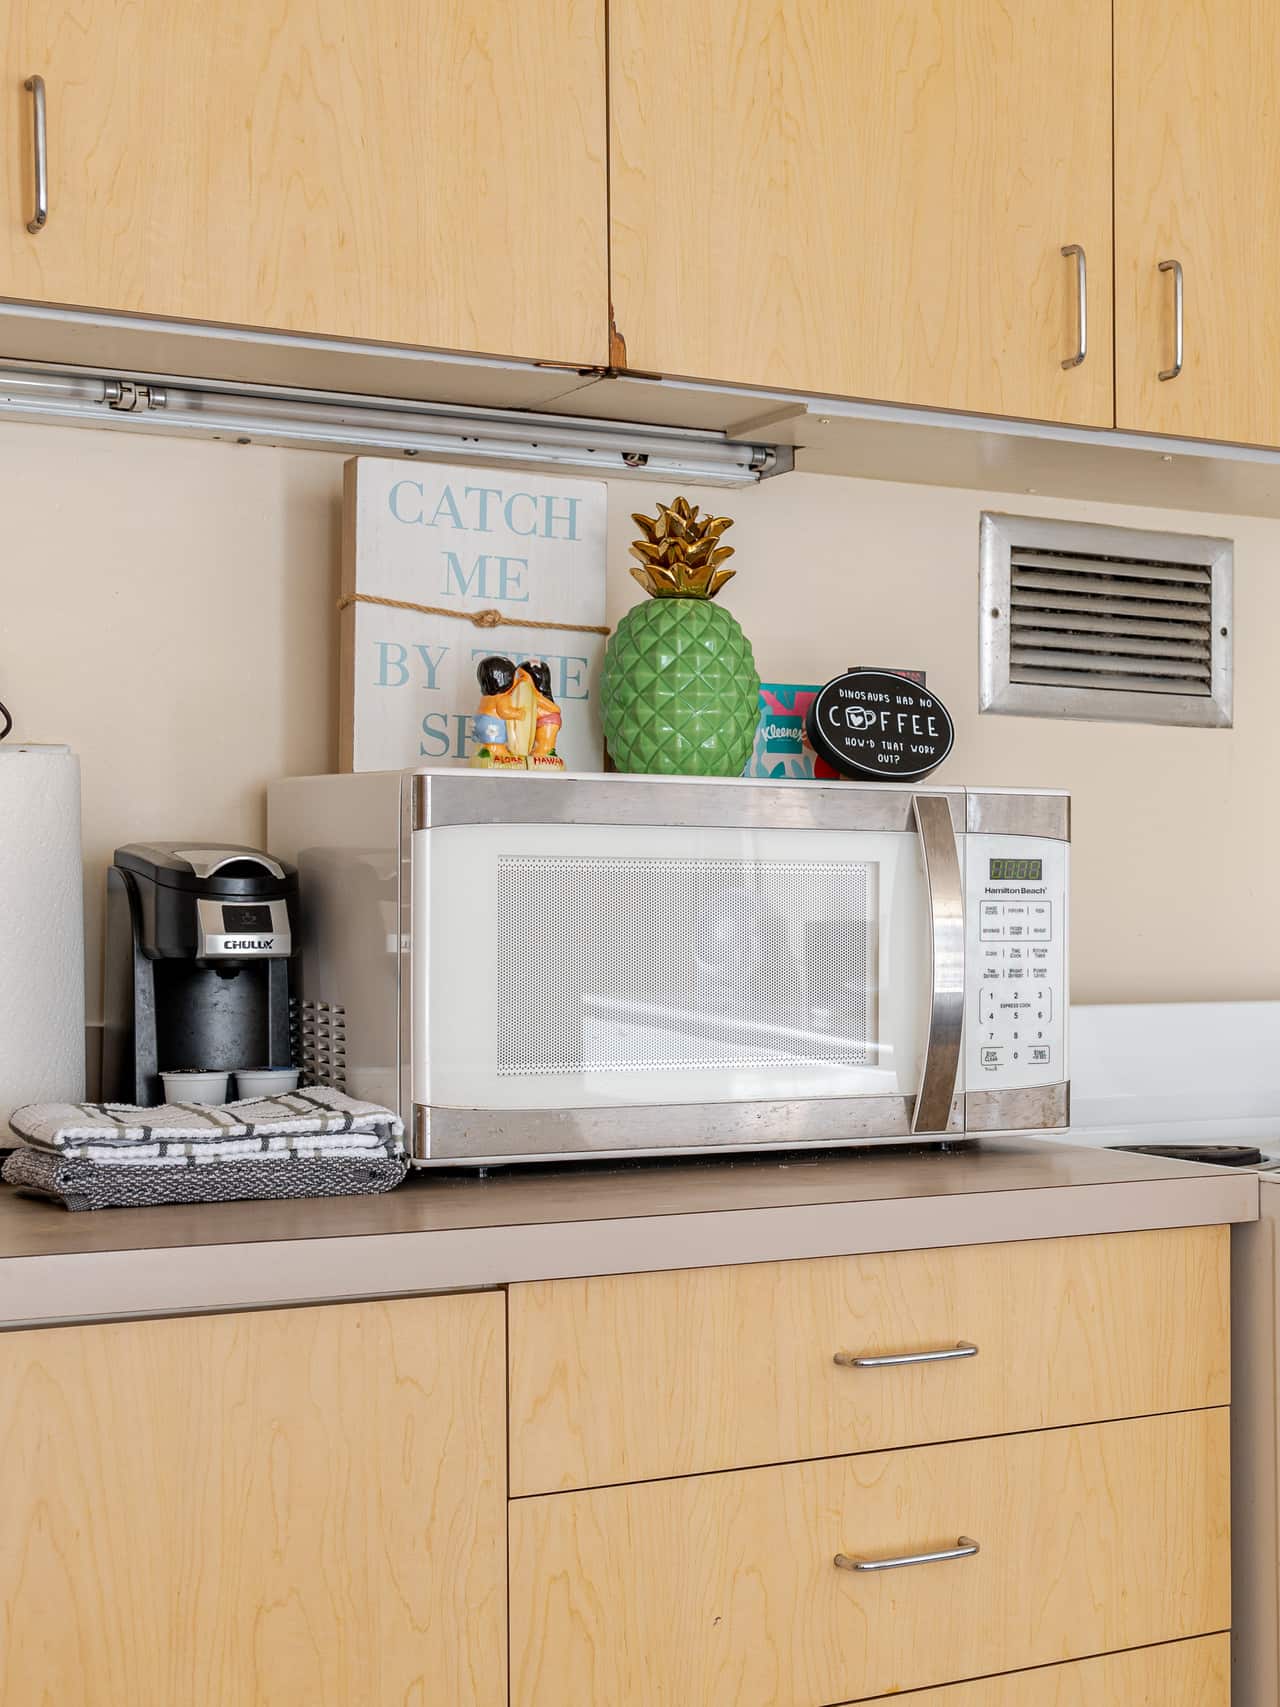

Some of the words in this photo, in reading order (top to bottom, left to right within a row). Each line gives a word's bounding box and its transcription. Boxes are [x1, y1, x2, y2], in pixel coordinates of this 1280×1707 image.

[388, 480, 582, 541] CATCH
[440, 551, 529, 602] ME
[373, 641, 450, 690] BY
[839, 688, 890, 703] DINOSAURS
[896, 695, 914, 705] HAD
[920, 698, 932, 708] NO
[761, 723, 807, 742] Kleenex
[845, 736, 875, 748] HOW'D
[882, 741, 903, 751] THAT
[910, 744, 935, 755] WORK
[877, 753, 900, 765] OUT?
[224, 938, 274, 950] CHULUX
